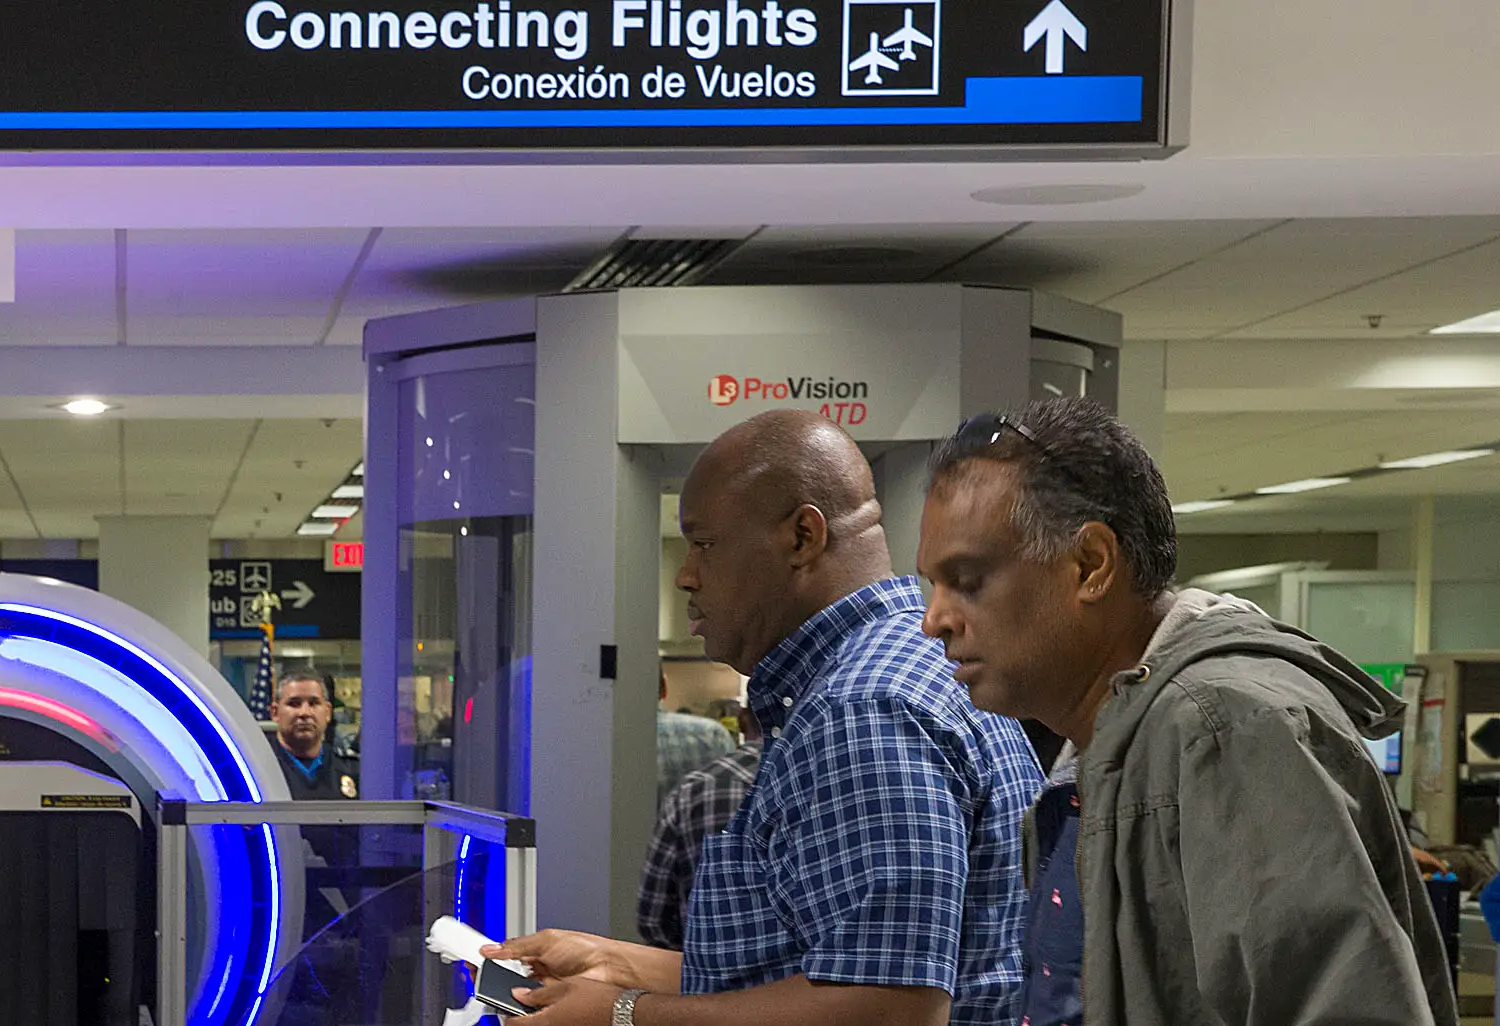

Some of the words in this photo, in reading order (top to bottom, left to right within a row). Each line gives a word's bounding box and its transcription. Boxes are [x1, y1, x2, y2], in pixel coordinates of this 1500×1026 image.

[246, 0, 587, 60] Connecting
[613, 0, 817, 60] Flights
[463, 65, 628, 99] Conexión
[642, 66, 685, 97] de
[696, 65, 815, 98] Vuelos
[744, 376, 868, 399] ProVision
[819, 402, 867, 425] ATD
[209, 570, 236, 586] 25
